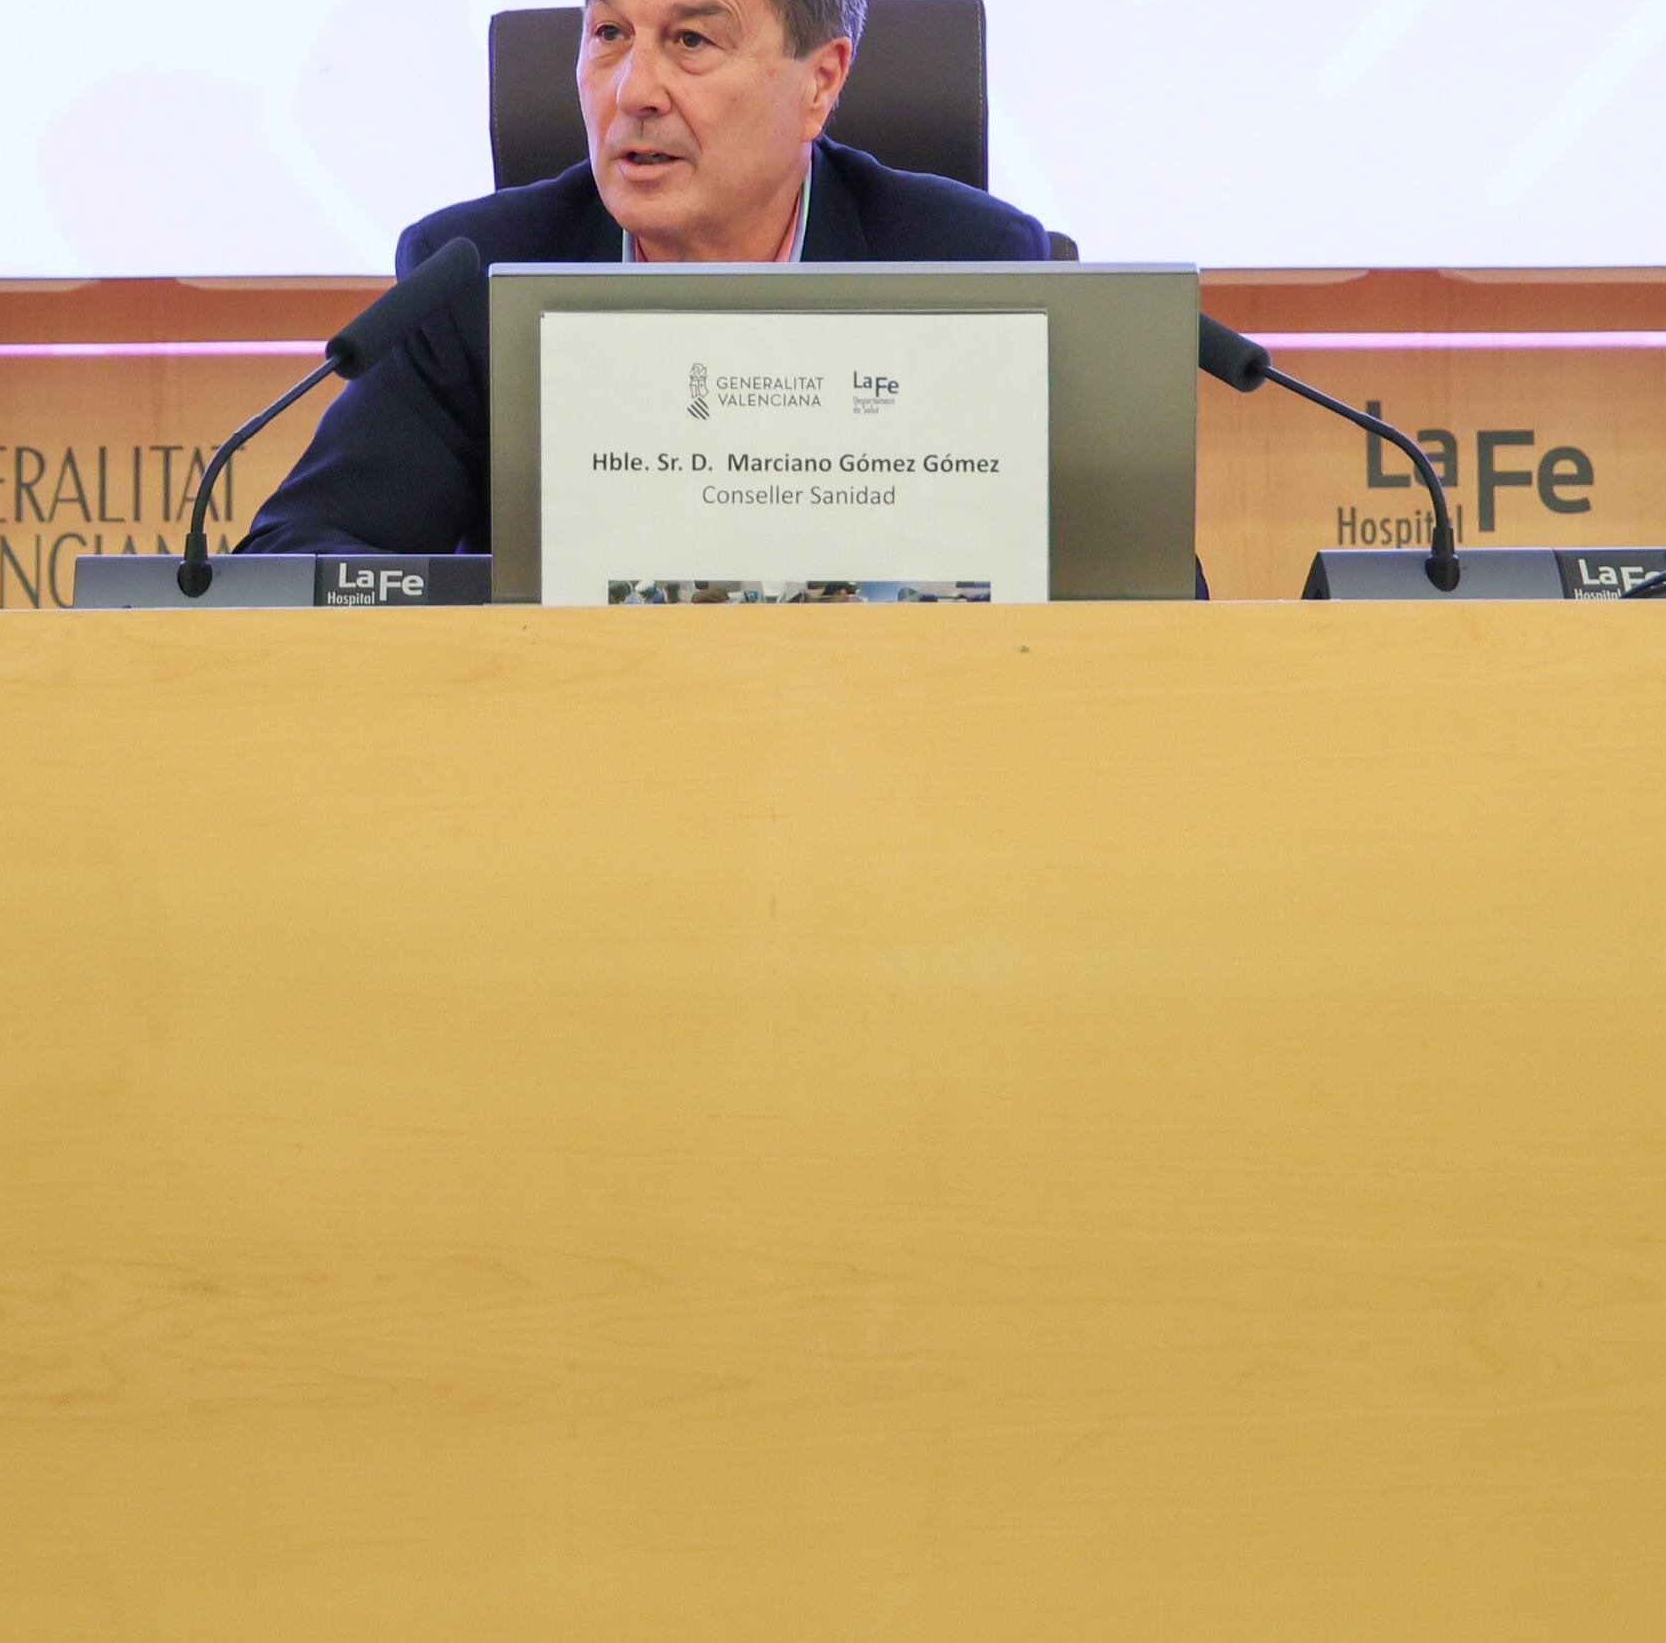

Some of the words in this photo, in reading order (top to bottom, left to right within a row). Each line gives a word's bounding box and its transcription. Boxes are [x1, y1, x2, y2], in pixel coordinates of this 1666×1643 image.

[715, 376, 825, 390] GENERALITAT
[717, 393, 822, 407] VALENCIANA
[592, 452, 650, 472] Hble.
[657, 453, 684, 472] Sr.
[691, 453, 713, 472] D.
[727, 453, 832, 473] Marciano
[839, 452, 916, 473] Gómez
[922, 453, 1000, 474] Gómez
[702, 485, 804, 505] Conseller
[810, 485, 896, 505] Sanidad
[1338, 504, 1463, 549] Hospitl
[327, 591, 375, 607] Hospital
